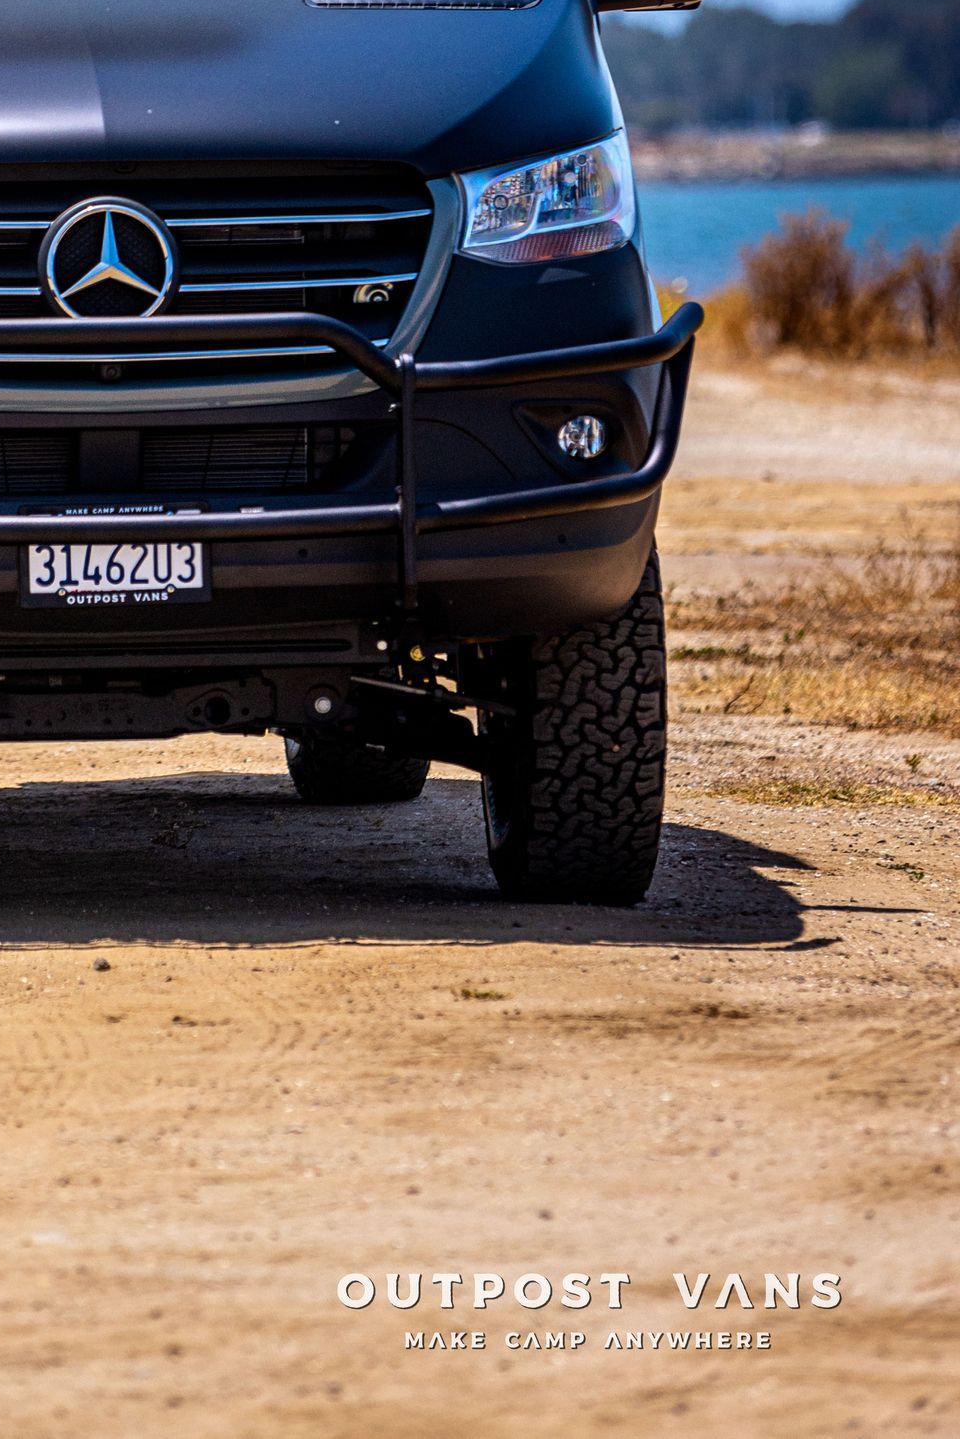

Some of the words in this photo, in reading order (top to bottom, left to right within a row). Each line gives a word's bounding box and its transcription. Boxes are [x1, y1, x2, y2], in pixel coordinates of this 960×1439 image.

[92, 507, 115, 515] CAMP
[118, 505, 164, 513] ANYWHERE
[35, 544, 196, 587] 31462U3
[66, 594, 127, 605] OUTPOST
[134, 592, 169, 602] VANS
